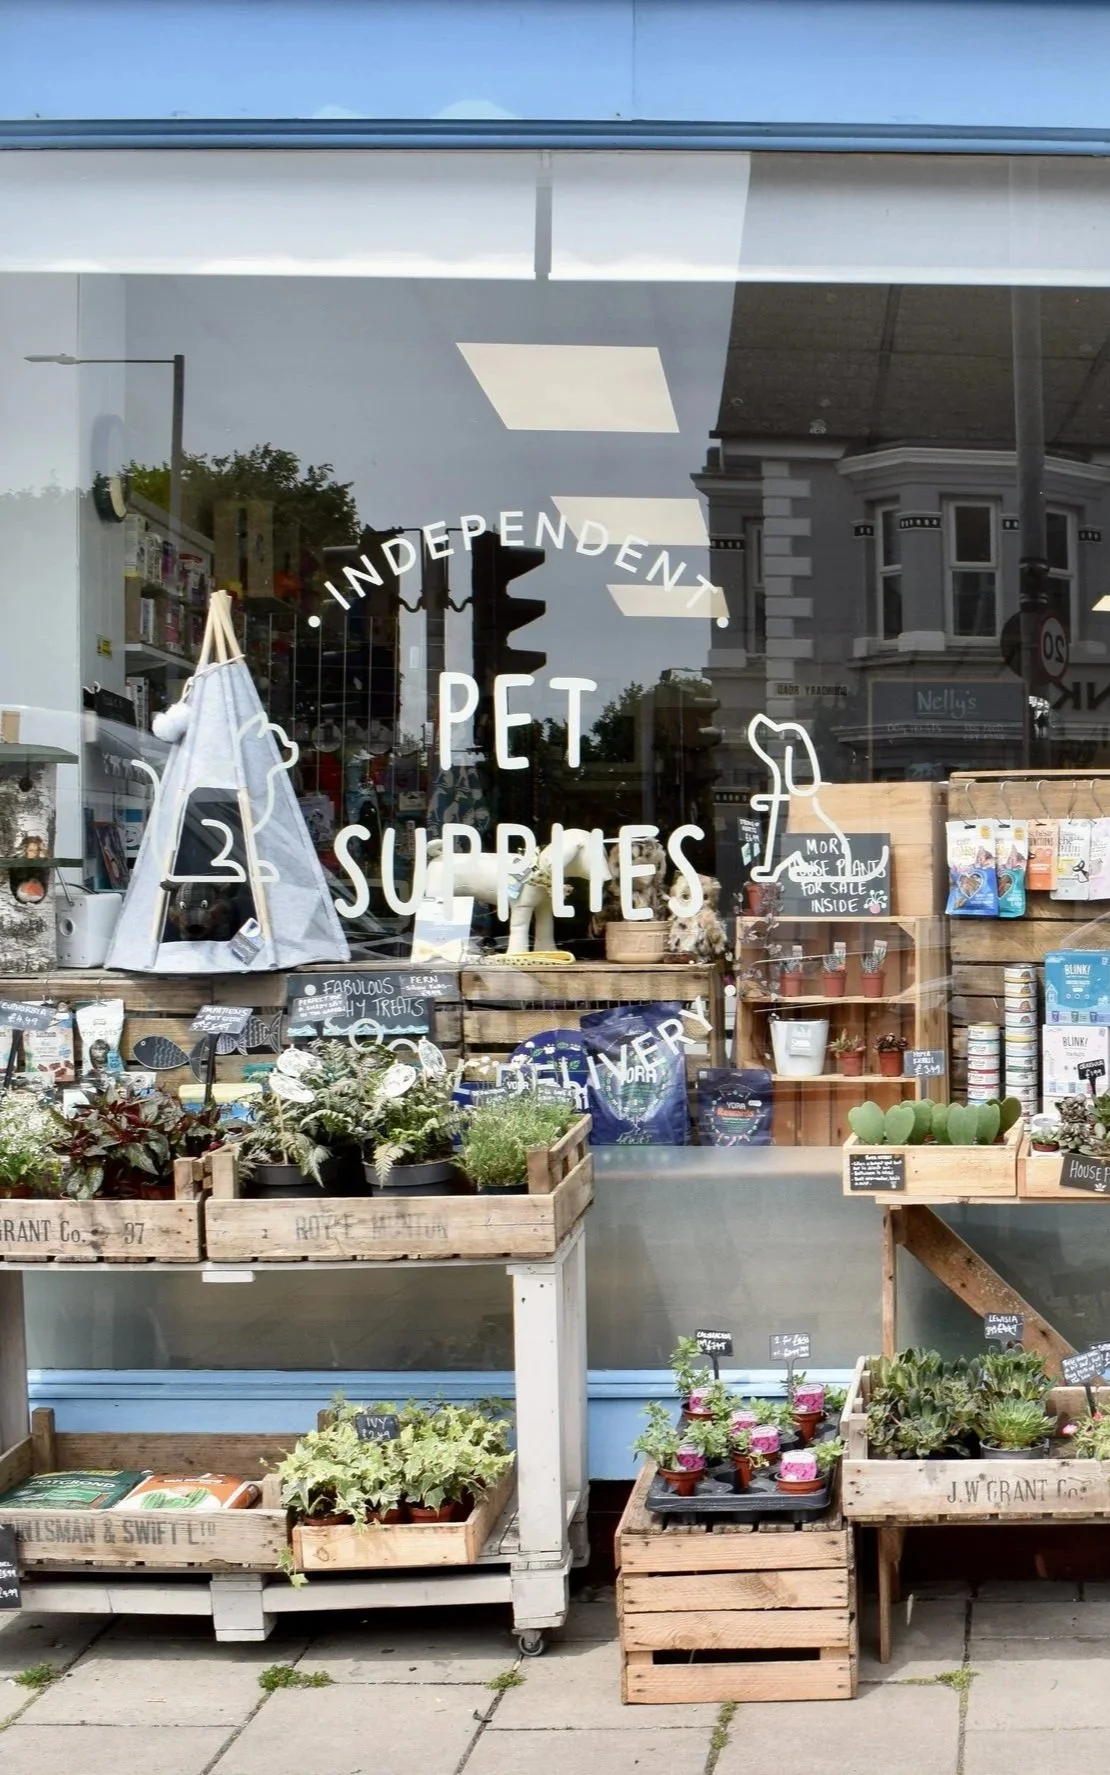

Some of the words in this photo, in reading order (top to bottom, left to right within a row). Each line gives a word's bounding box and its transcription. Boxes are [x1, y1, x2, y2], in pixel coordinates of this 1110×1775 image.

[324, 510, 719, 611] INDEPENDENT
[916, 688, 978, 718] Nelly's
[439, 671, 598, 771] PET
[333, 824, 705, 922] SUPPLIES
[801, 881, 826, 897] FOR
[829, 881, 867, 896] SALE
[812, 898, 859, 914] INSIDE
[1064, 964, 1091, 975] BLINK!
[323, 977, 394, 996] FABULOUS
[410, 975, 439, 984] FERN
[375, 998, 425, 1018] TREATS
[1062, 1036, 1089, 1048] BLINK!
[726, 1101, 746, 1109] YORA
[1069, 1159, 1103, 1182] HOUSE
[0, 1219, 50, 1242] RANT
[124, 1222, 145, 1245] 97
[988, 1314, 1018, 1324] LEWISIA
[366, 1417, 388, 1430] IVY
[29, 1479, 116, 1488] POTGROND
[987, 1479, 1048, 1504] GRANT
[103, 1518, 117, 1544] &
[122, 1518, 178, 1545] SWIFT
